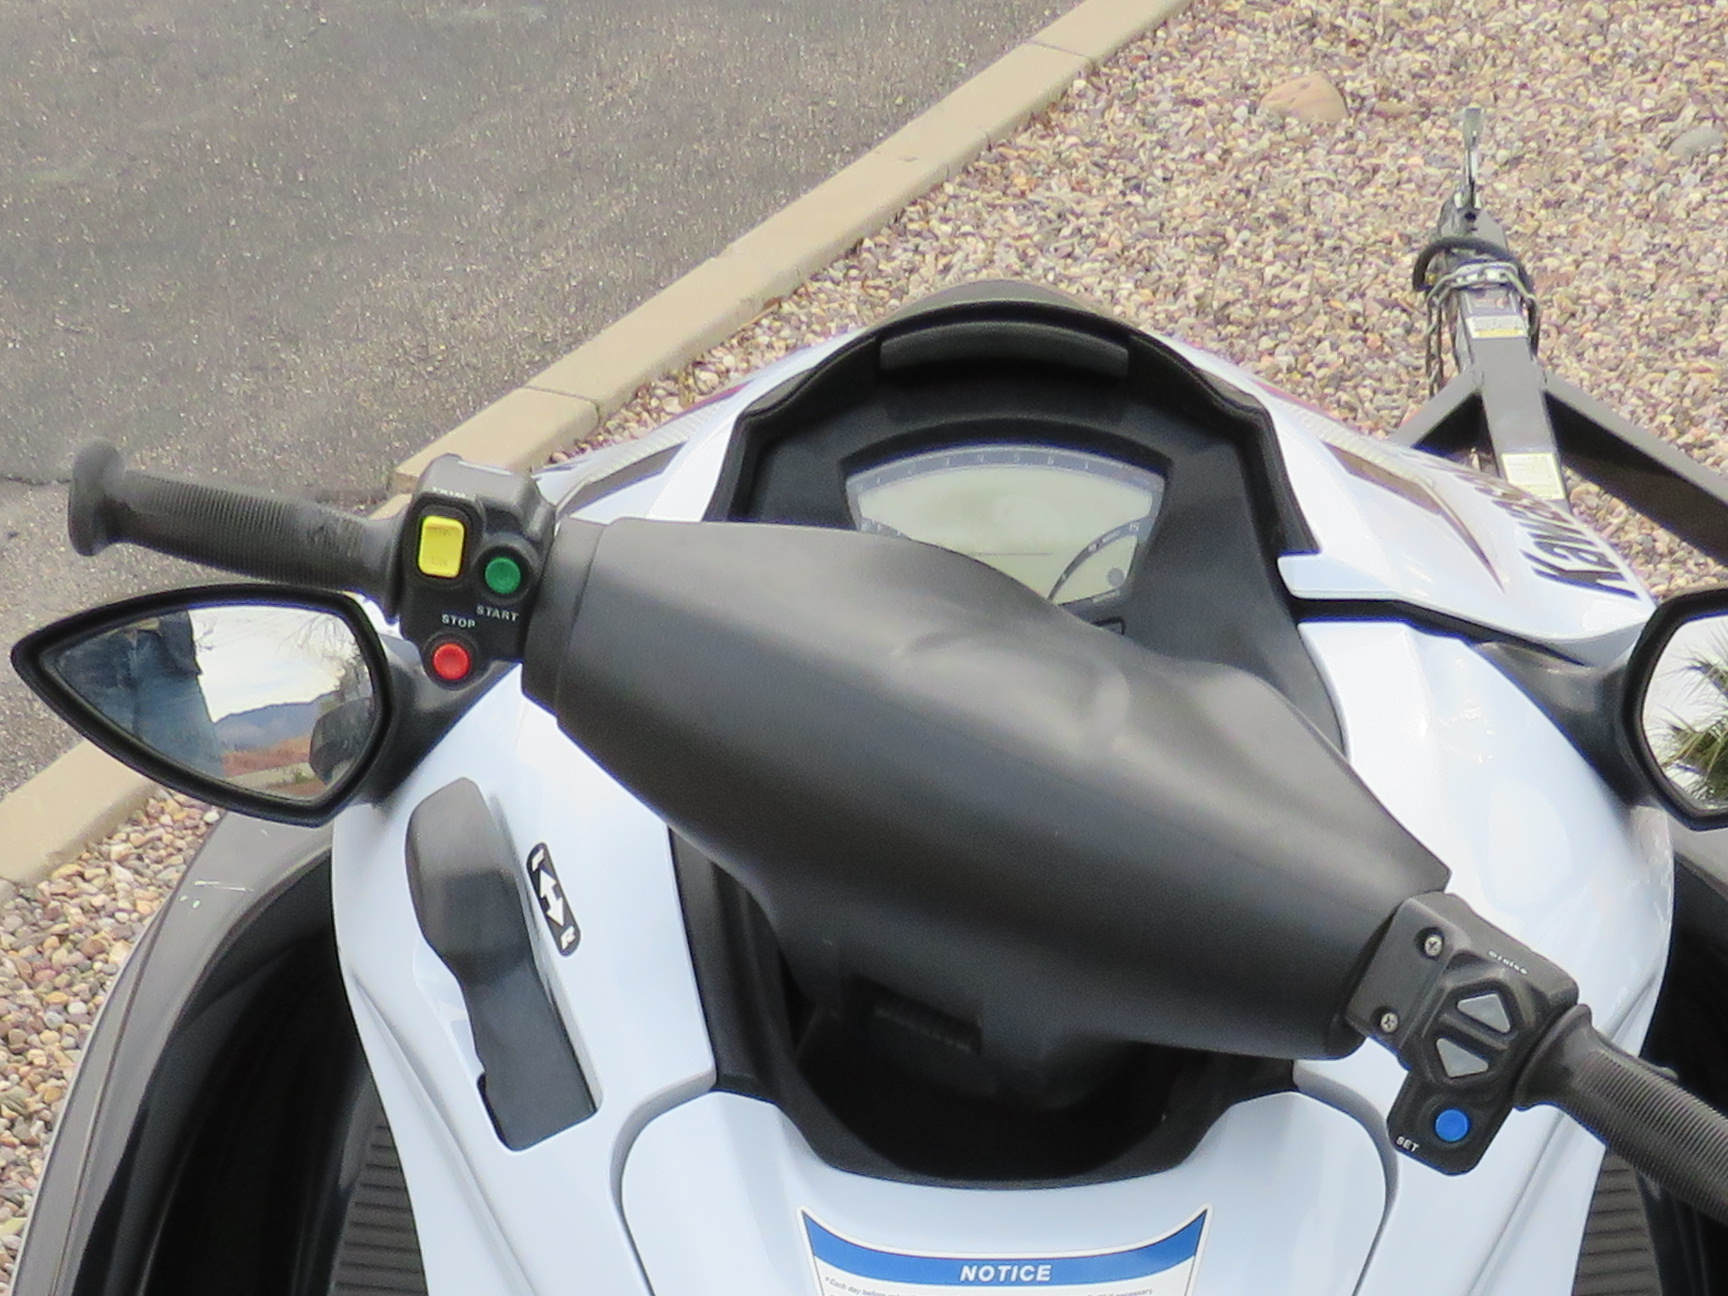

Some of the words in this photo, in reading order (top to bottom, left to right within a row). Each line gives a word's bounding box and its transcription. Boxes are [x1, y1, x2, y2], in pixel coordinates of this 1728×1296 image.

[441, 614, 476, 629] STOP
[476, 605, 520, 623] START
[1395, 1135, 1420, 1153] SET
[958, 1263, 1052, 1283] NOTICE
